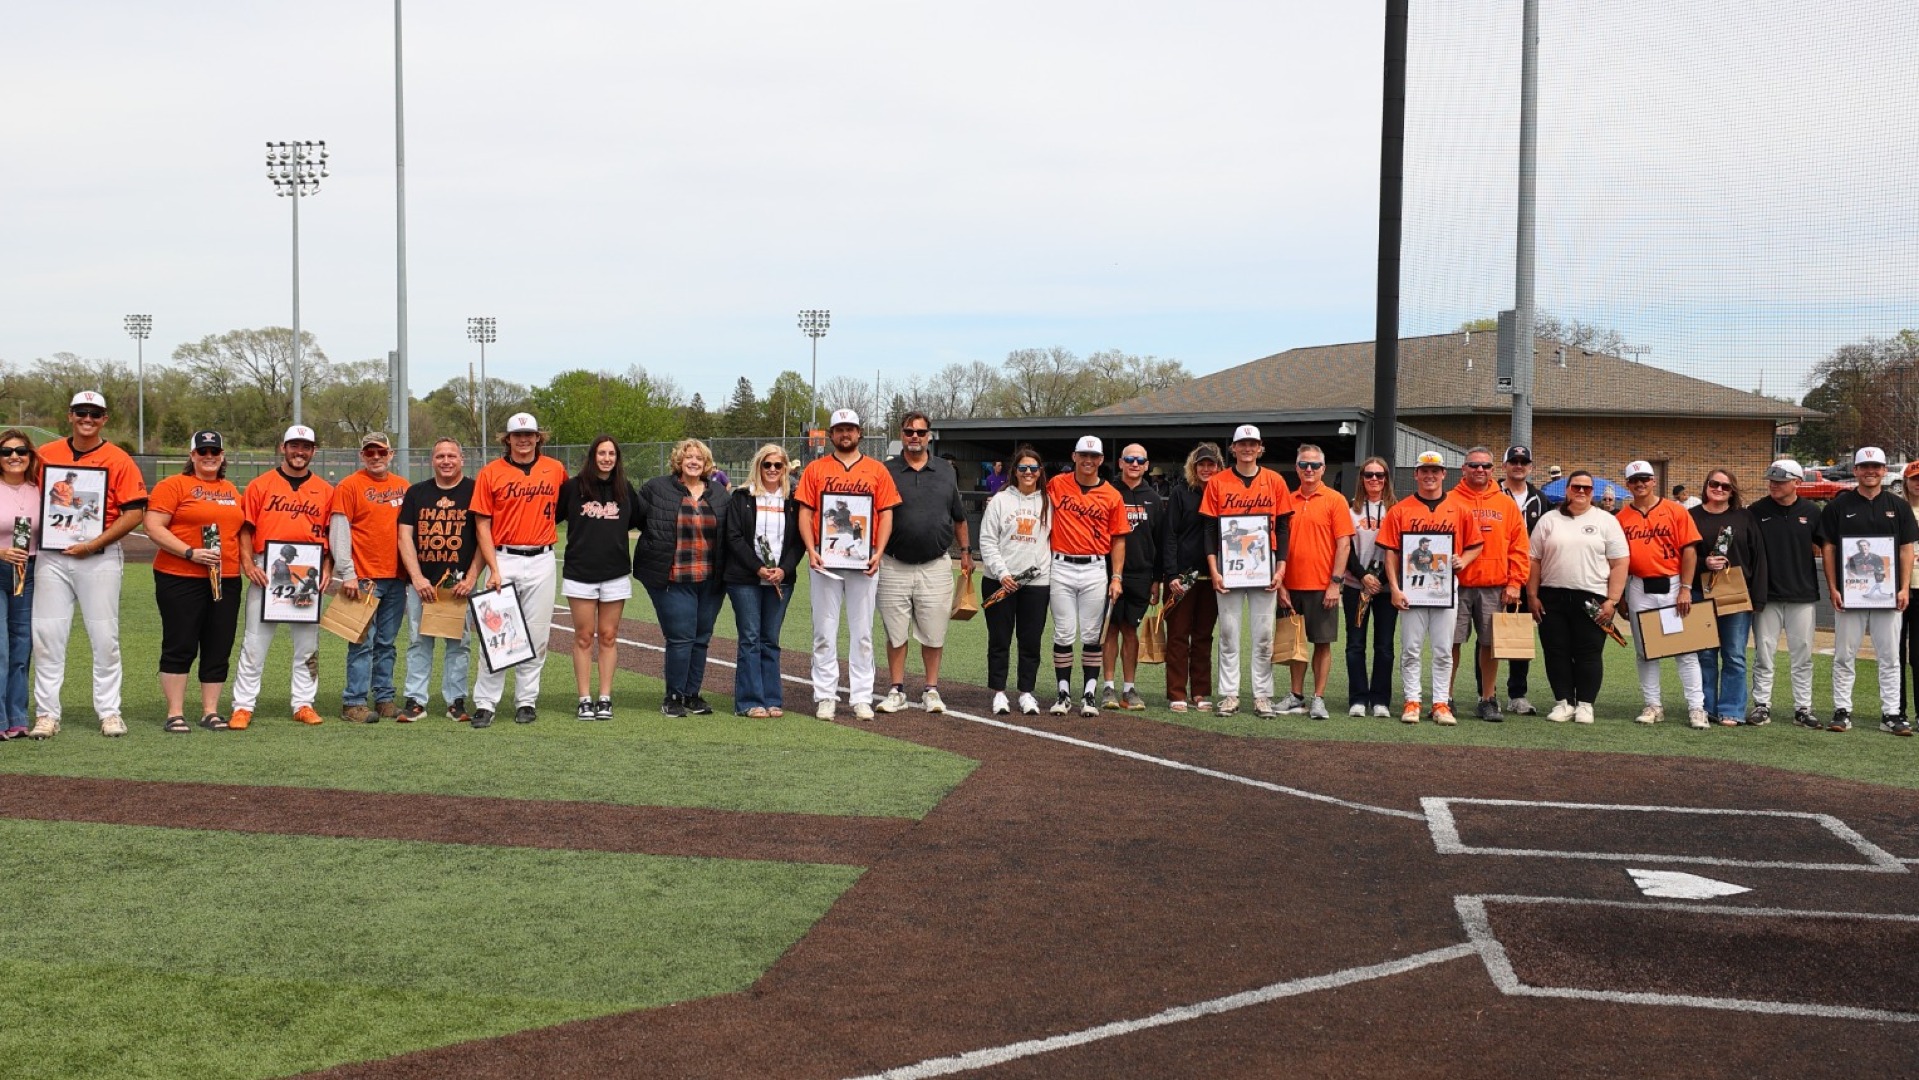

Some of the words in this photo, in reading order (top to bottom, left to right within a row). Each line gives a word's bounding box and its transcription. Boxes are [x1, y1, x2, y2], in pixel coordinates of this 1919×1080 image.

[504, 480, 555, 503] Knights
[264, 494, 321, 519] Knights
[1056, 495, 1109, 521] Knights
[1221, 493, 1275, 515] Knights
[420, 508, 467, 520] SHARK
[1472, 509, 1503, 521] TBURG
[418, 521, 466, 536] BAIT
[1625, 523, 1671, 545] Knights
[419, 535, 462, 550] HOO
[418, 550, 459, 562] HAHA
